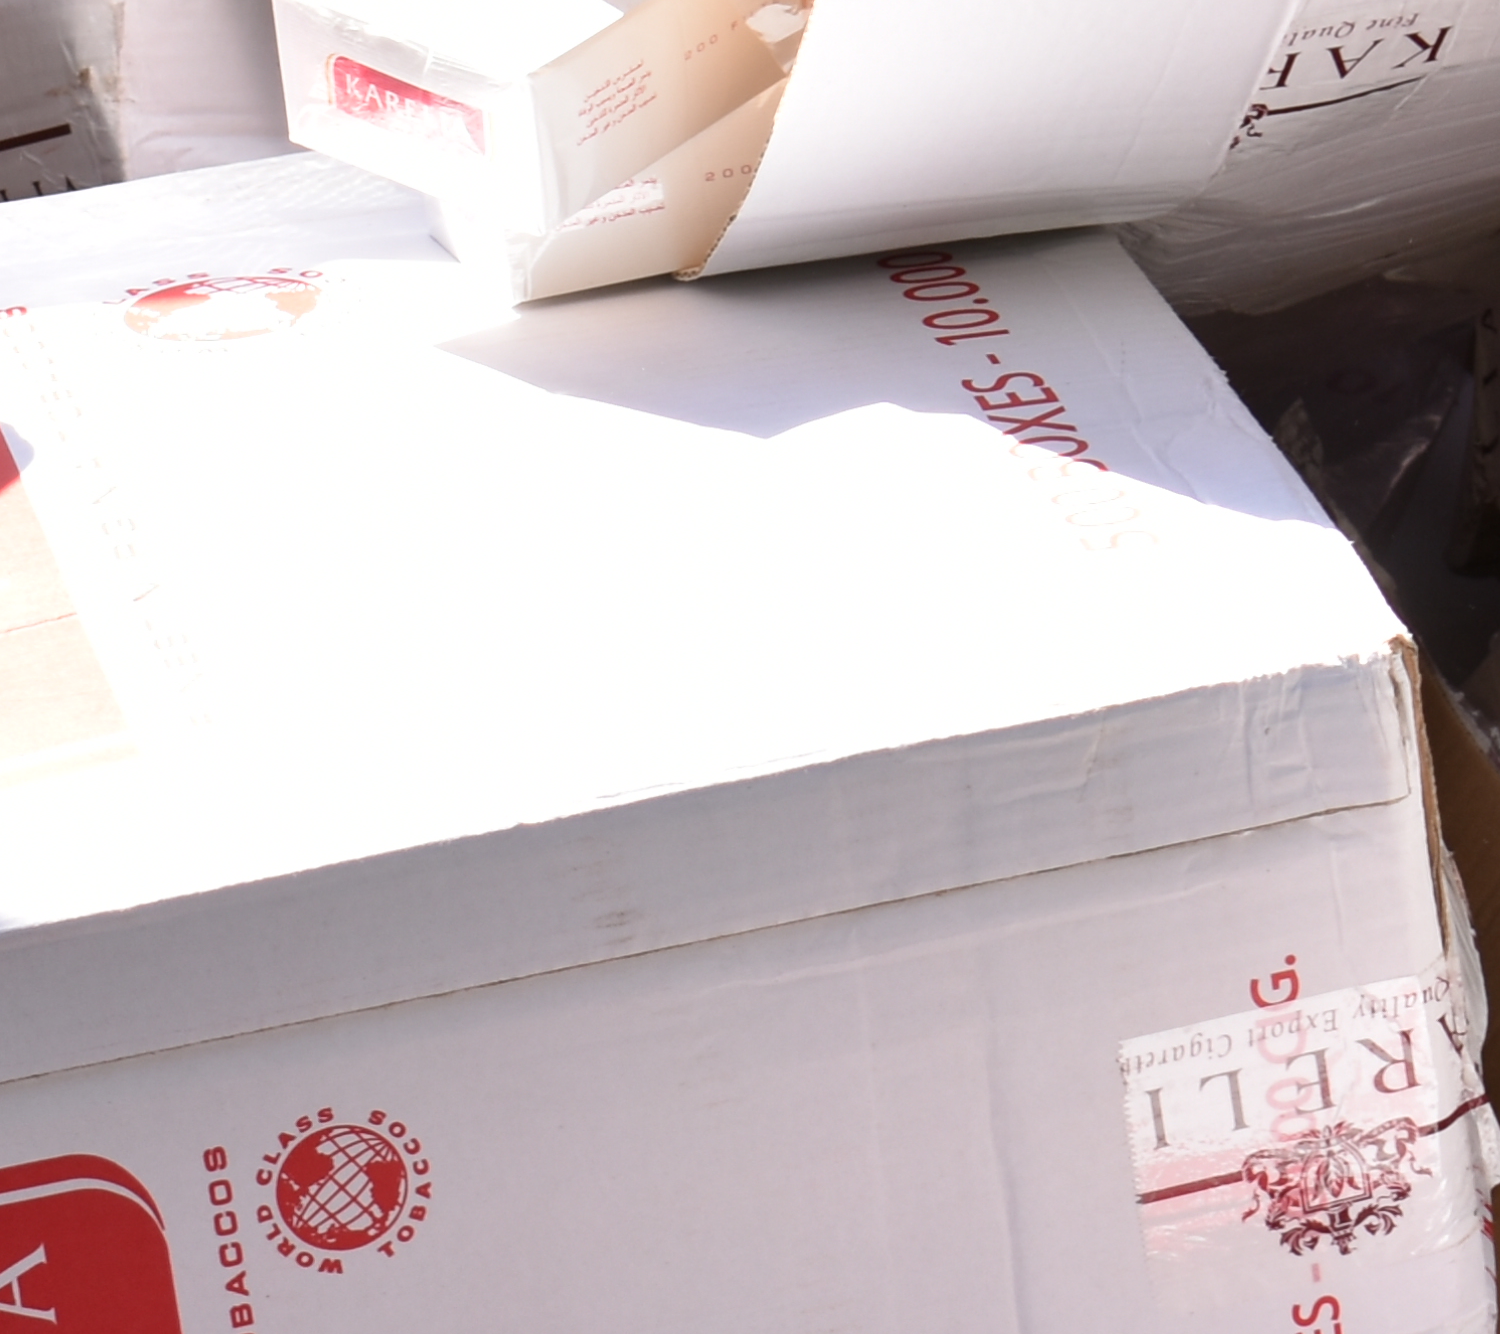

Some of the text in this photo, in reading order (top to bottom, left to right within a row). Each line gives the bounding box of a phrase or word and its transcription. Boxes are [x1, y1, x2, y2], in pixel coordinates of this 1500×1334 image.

[877, 251, 1011, 346] 10.000
[1247, 1008, 1339, 1048] Export
[254, 1107, 434, 1275] WORLD CLASS TOBACCOS
